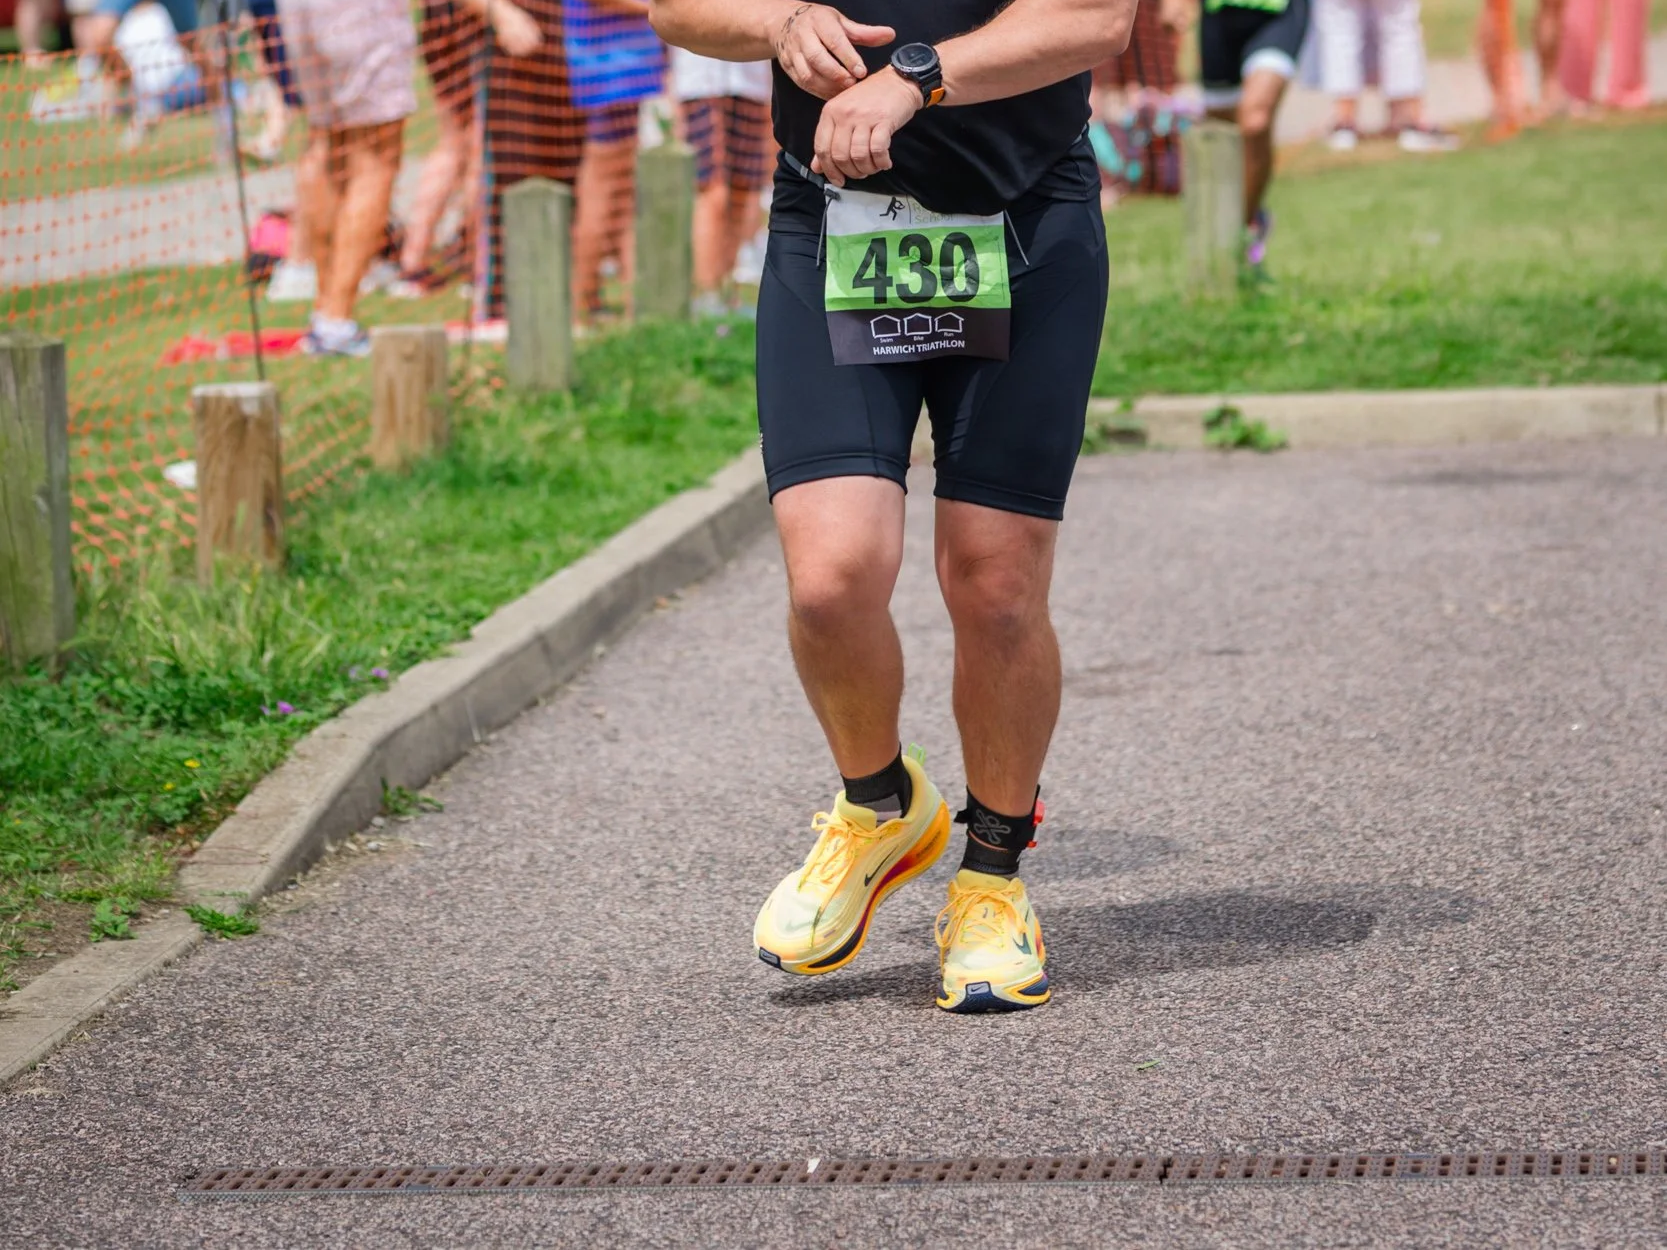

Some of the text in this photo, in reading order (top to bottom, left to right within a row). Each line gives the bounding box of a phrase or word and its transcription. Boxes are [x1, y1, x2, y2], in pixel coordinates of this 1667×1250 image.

[852, 232, 980, 304] 430
[873, 340, 965, 355] HARWICH TRIATHLON
